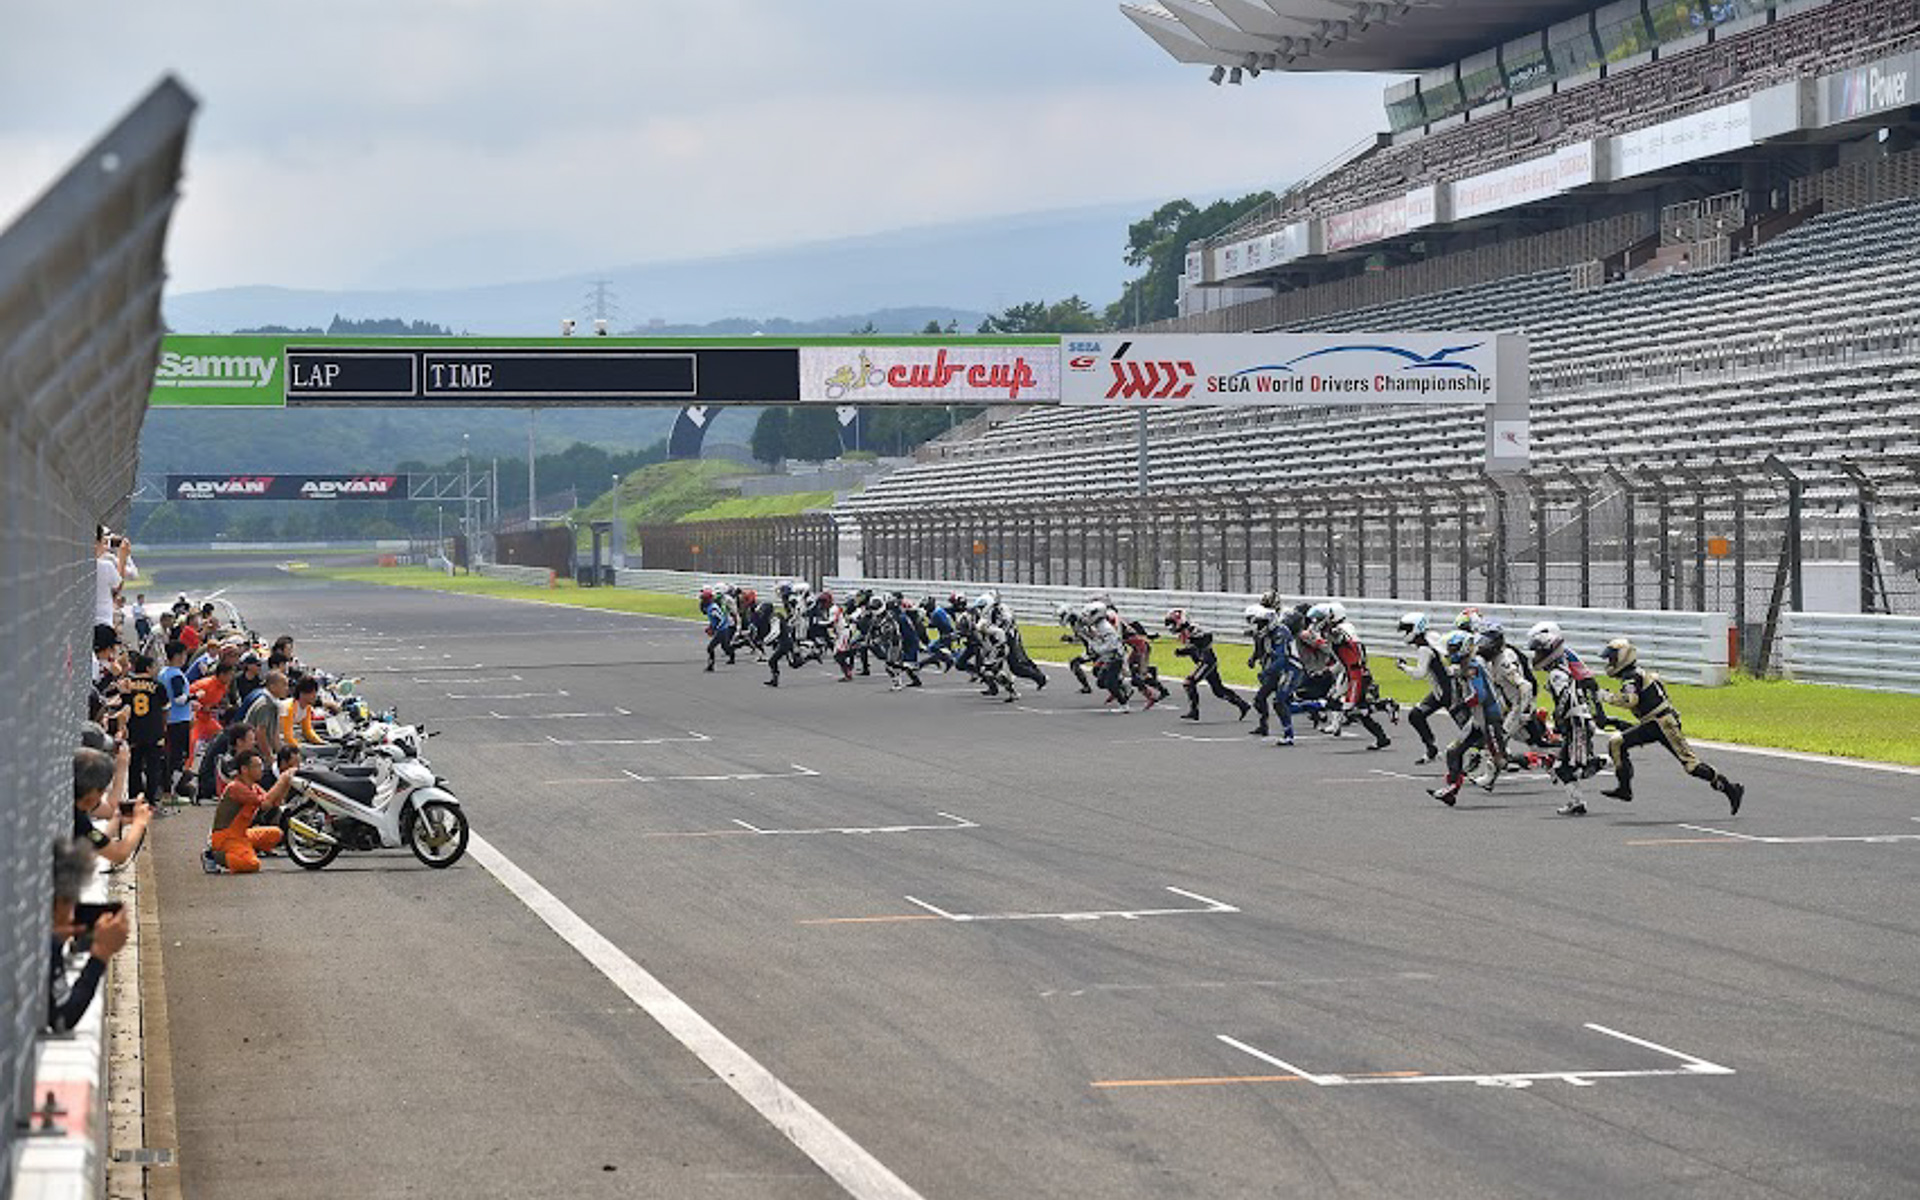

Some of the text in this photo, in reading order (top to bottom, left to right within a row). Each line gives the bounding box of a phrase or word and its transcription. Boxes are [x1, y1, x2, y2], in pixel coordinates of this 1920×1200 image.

[1870, 68, 1907, 109] Power
[155, 352, 278, 388] Sammy
[293, 364, 340, 387] LAP
[430, 364, 492, 388] TIME
[887, 349, 1037, 399] cub cup
[1207, 374, 1491, 394] SEGA World Drivers Championship
[178, 480, 267, 493] ADVAN
[301, 480, 388, 493] ADVAN
[134, 692, 150, 717] 8
